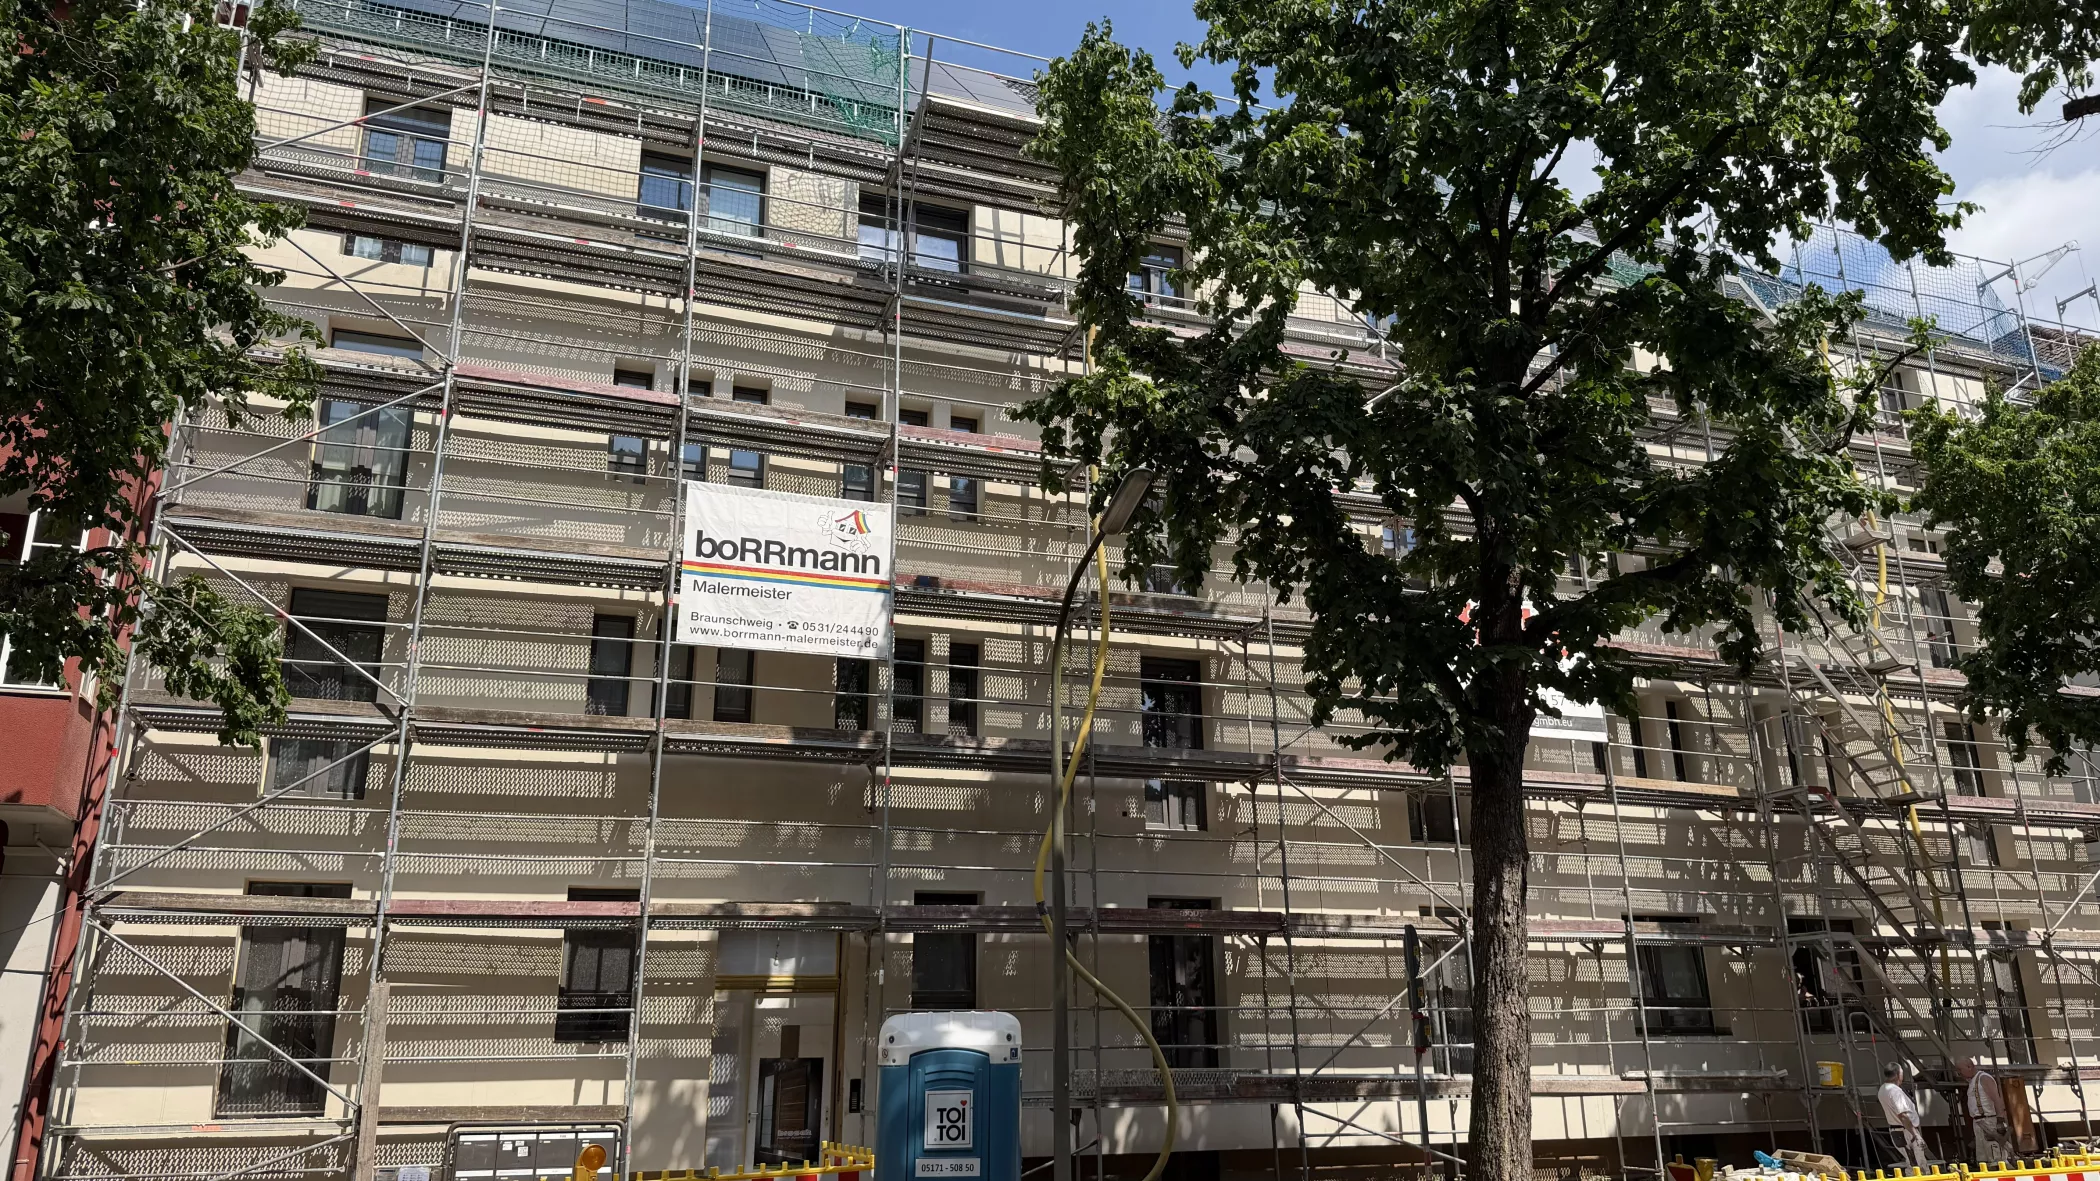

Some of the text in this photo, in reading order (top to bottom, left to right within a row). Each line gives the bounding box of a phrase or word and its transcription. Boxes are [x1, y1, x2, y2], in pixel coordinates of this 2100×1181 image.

[696, 530, 880, 575] boRRmann
[693, 579, 792, 600] Malermeister
[690, 611, 773, 630] Braunschweig
[690, 625, 878, 649] www.borrmann-malermeister.de
[1533, 717, 1573, 727] gmbh.eu
[936, 1107, 966, 1124] TOI
[936, 1125, 966, 1142] TOI
[921, 1164, 944, 1172] 05171
[949, 1163, 963, 1172] 508
[965, 1163, 975, 1172] 50
